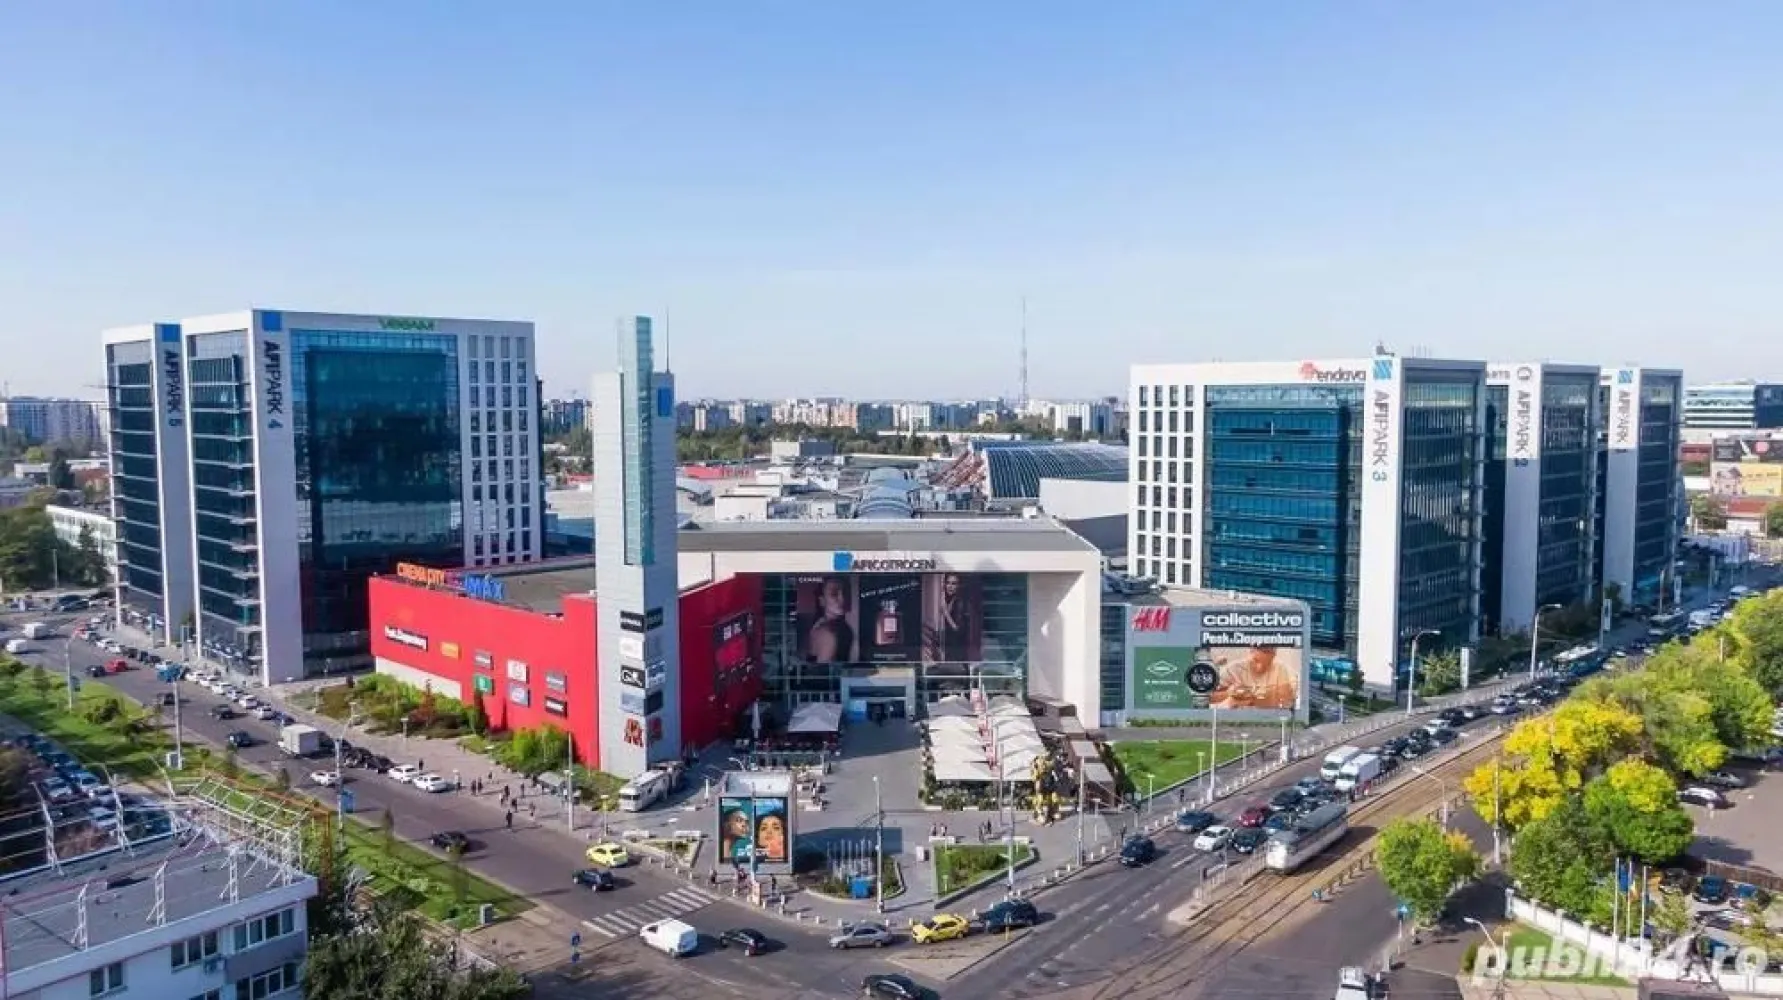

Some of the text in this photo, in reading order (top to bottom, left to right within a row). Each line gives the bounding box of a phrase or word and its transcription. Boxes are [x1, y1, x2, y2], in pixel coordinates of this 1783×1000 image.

[268, 419, 284, 429] 4
[1372, 471, 1387, 482] 3
[1202, 612, 1303, 628] collective
